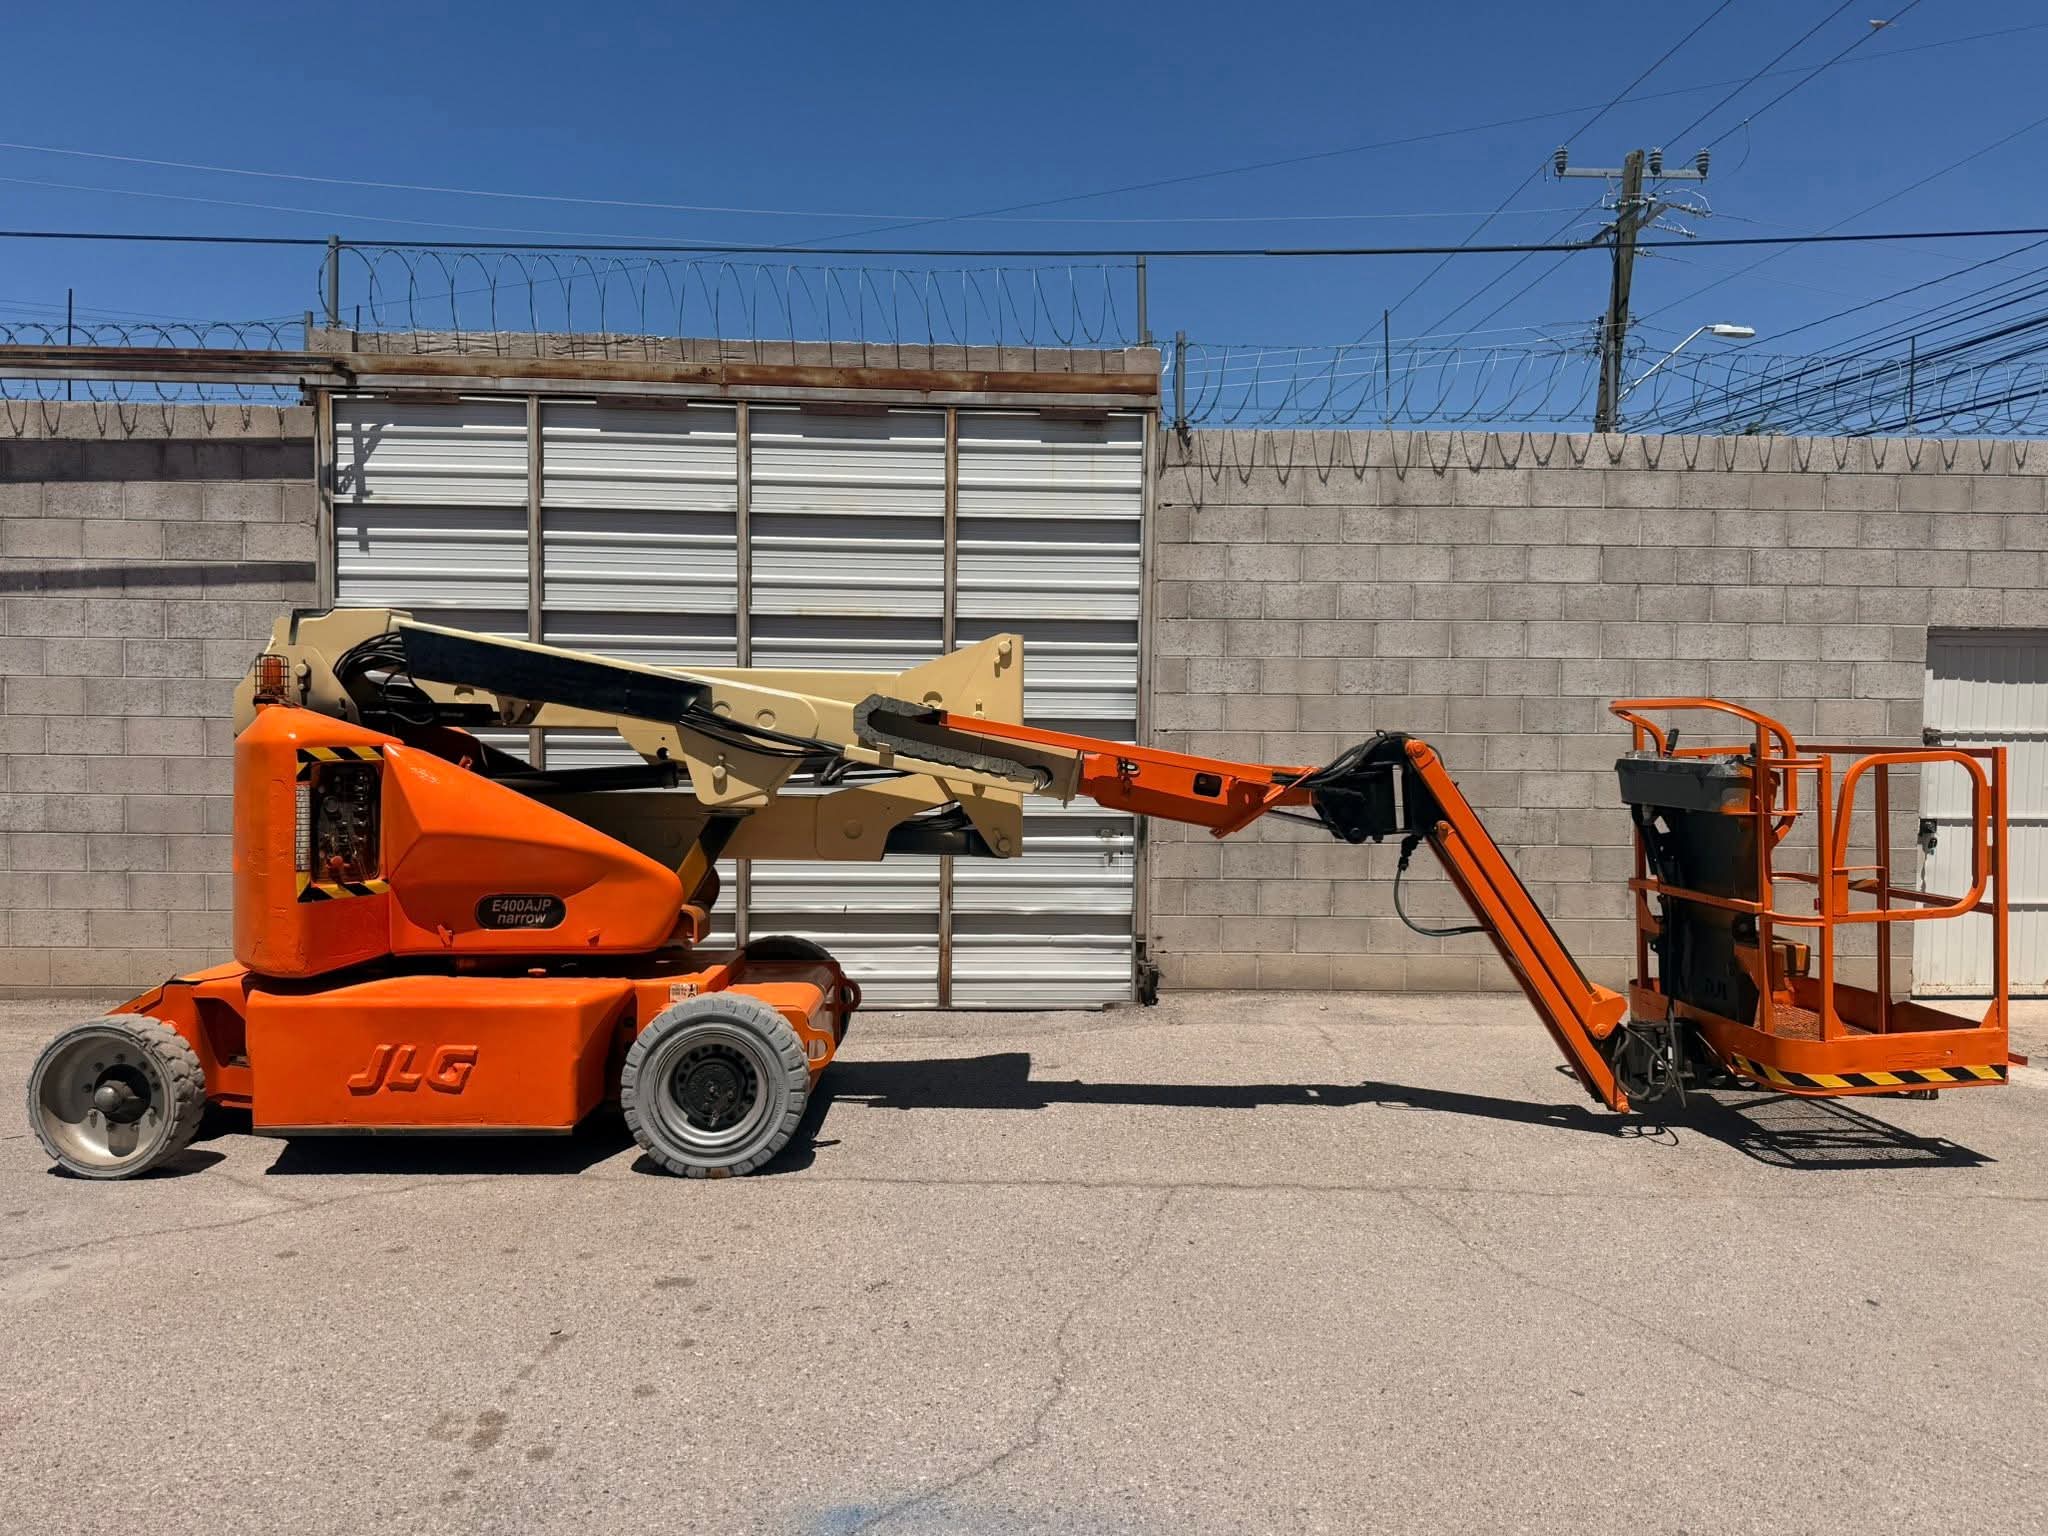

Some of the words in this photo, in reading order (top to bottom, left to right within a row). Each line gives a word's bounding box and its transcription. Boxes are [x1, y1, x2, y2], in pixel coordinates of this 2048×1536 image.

[492, 899, 552, 912] E400AJP
[497, 913, 547, 924] narrow
[347, 1044, 478, 1096] JLG
